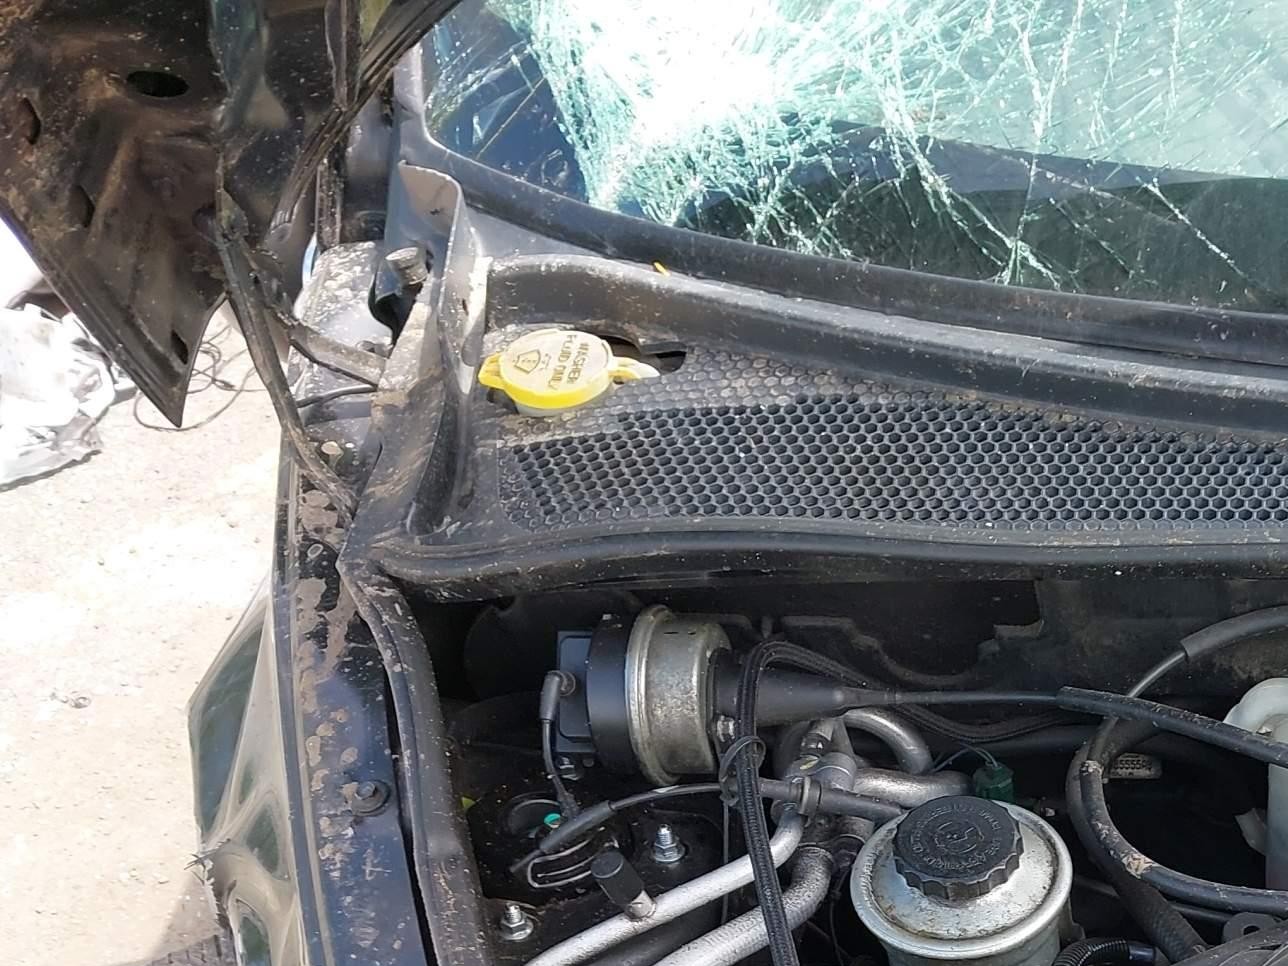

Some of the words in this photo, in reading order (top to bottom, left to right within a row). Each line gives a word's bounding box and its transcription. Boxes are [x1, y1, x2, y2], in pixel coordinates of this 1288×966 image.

[557, 334, 580, 368] FLUID
[567, 341, 591, 385] WASHER
[547, 362, 570, 391] ONLY
